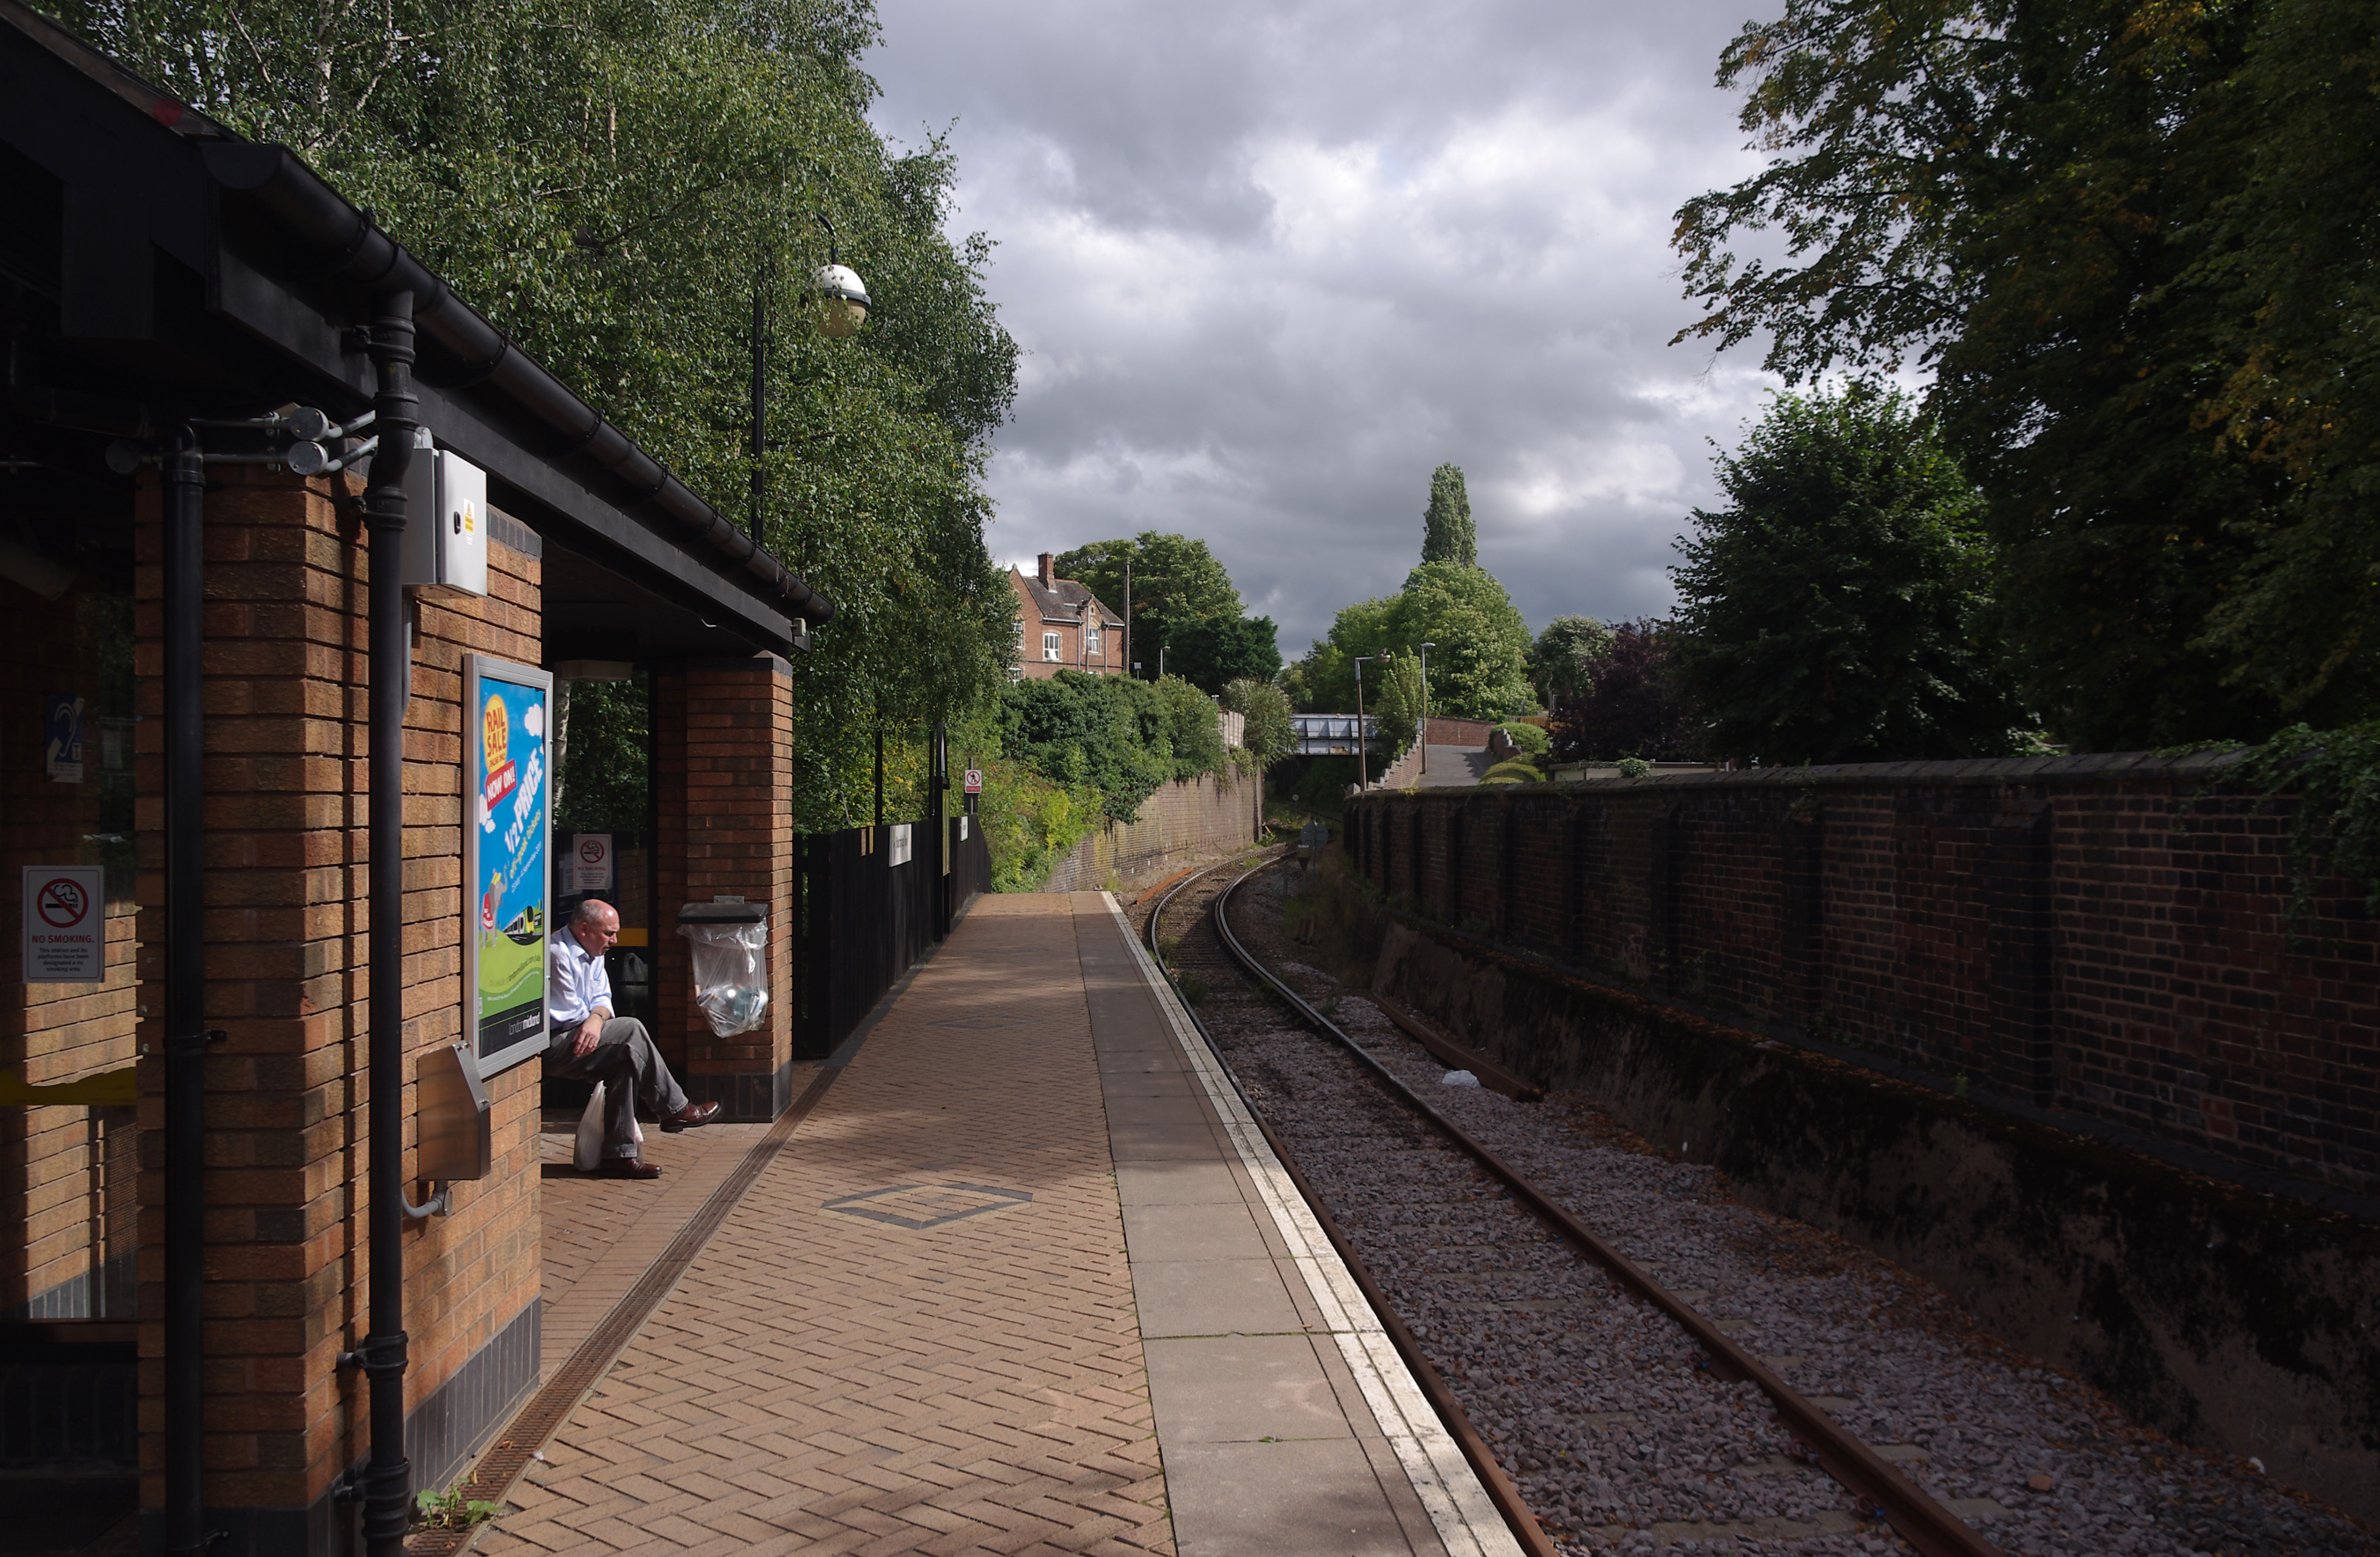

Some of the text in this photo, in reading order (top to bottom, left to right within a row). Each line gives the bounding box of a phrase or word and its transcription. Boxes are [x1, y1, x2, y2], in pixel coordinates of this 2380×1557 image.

[486, 706, 505, 734] RAIL
[487, 727, 506, 757] SALE
[487, 765, 516, 802] NOW ON!
[504, 821, 520, 854] 1/2
[513, 747, 543, 833] PRICE
[32, 935, 95, 943] NO SMOKING.
